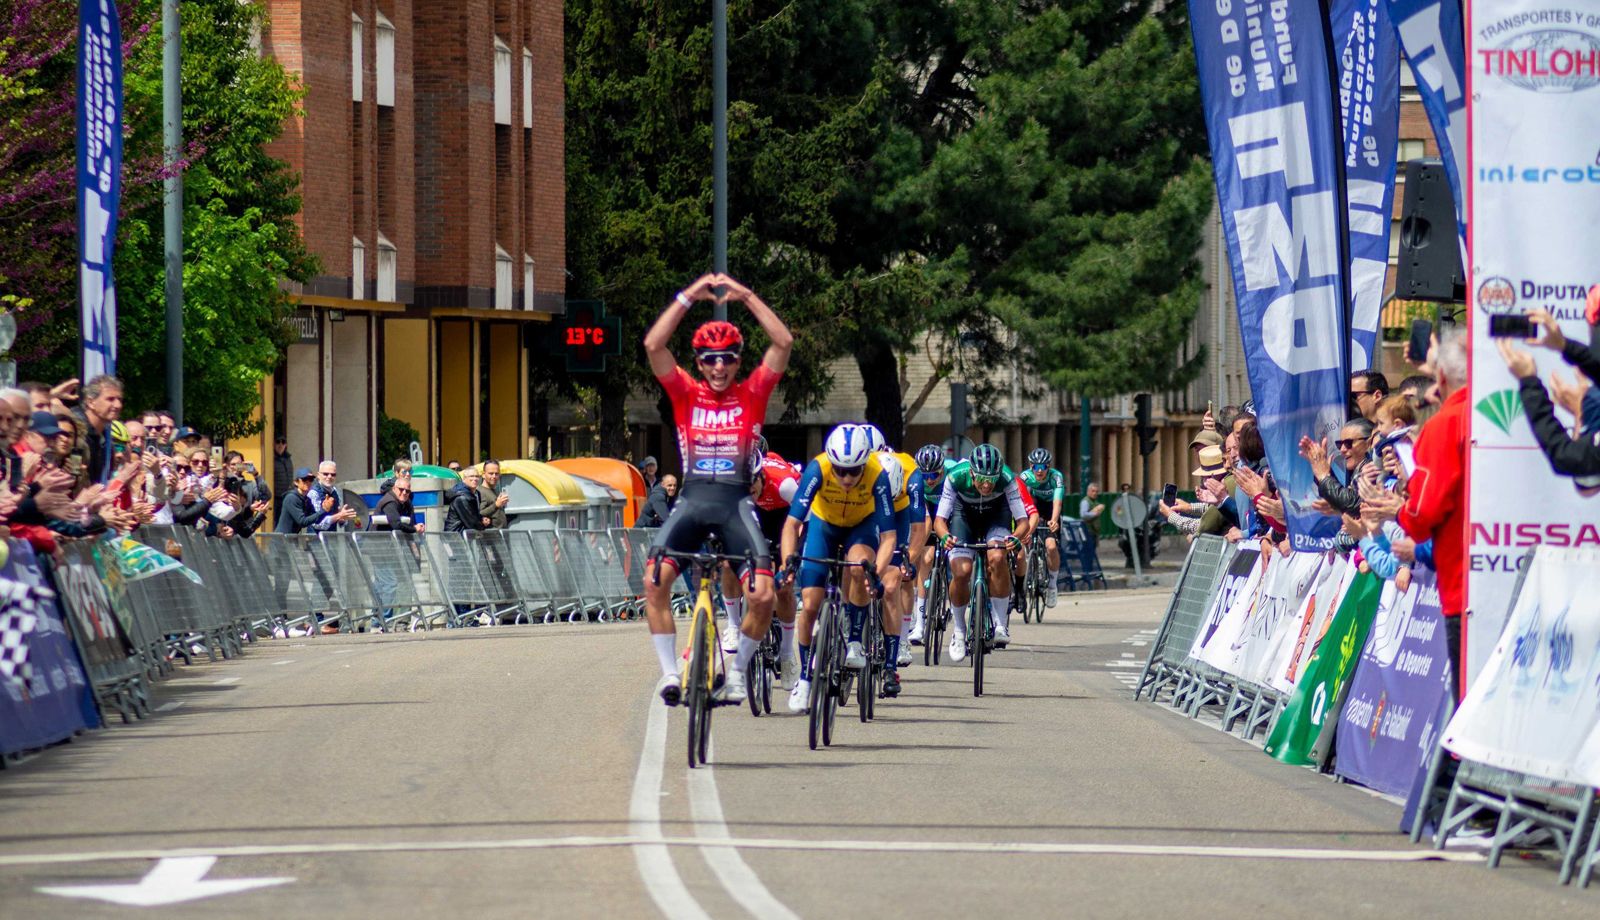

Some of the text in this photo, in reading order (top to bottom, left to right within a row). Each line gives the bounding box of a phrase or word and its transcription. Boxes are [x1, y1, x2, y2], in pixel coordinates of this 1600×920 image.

[1479, 9, 1572, 41] TRANSPORTES
[1575, 11, 1584, 25] Y
[1477, 47, 1600, 77] TINLOH
[1362, 135, 1380, 167] de
[566, 327, 605, 345] 13°C
[1470, 521, 1600, 548] NISSA
